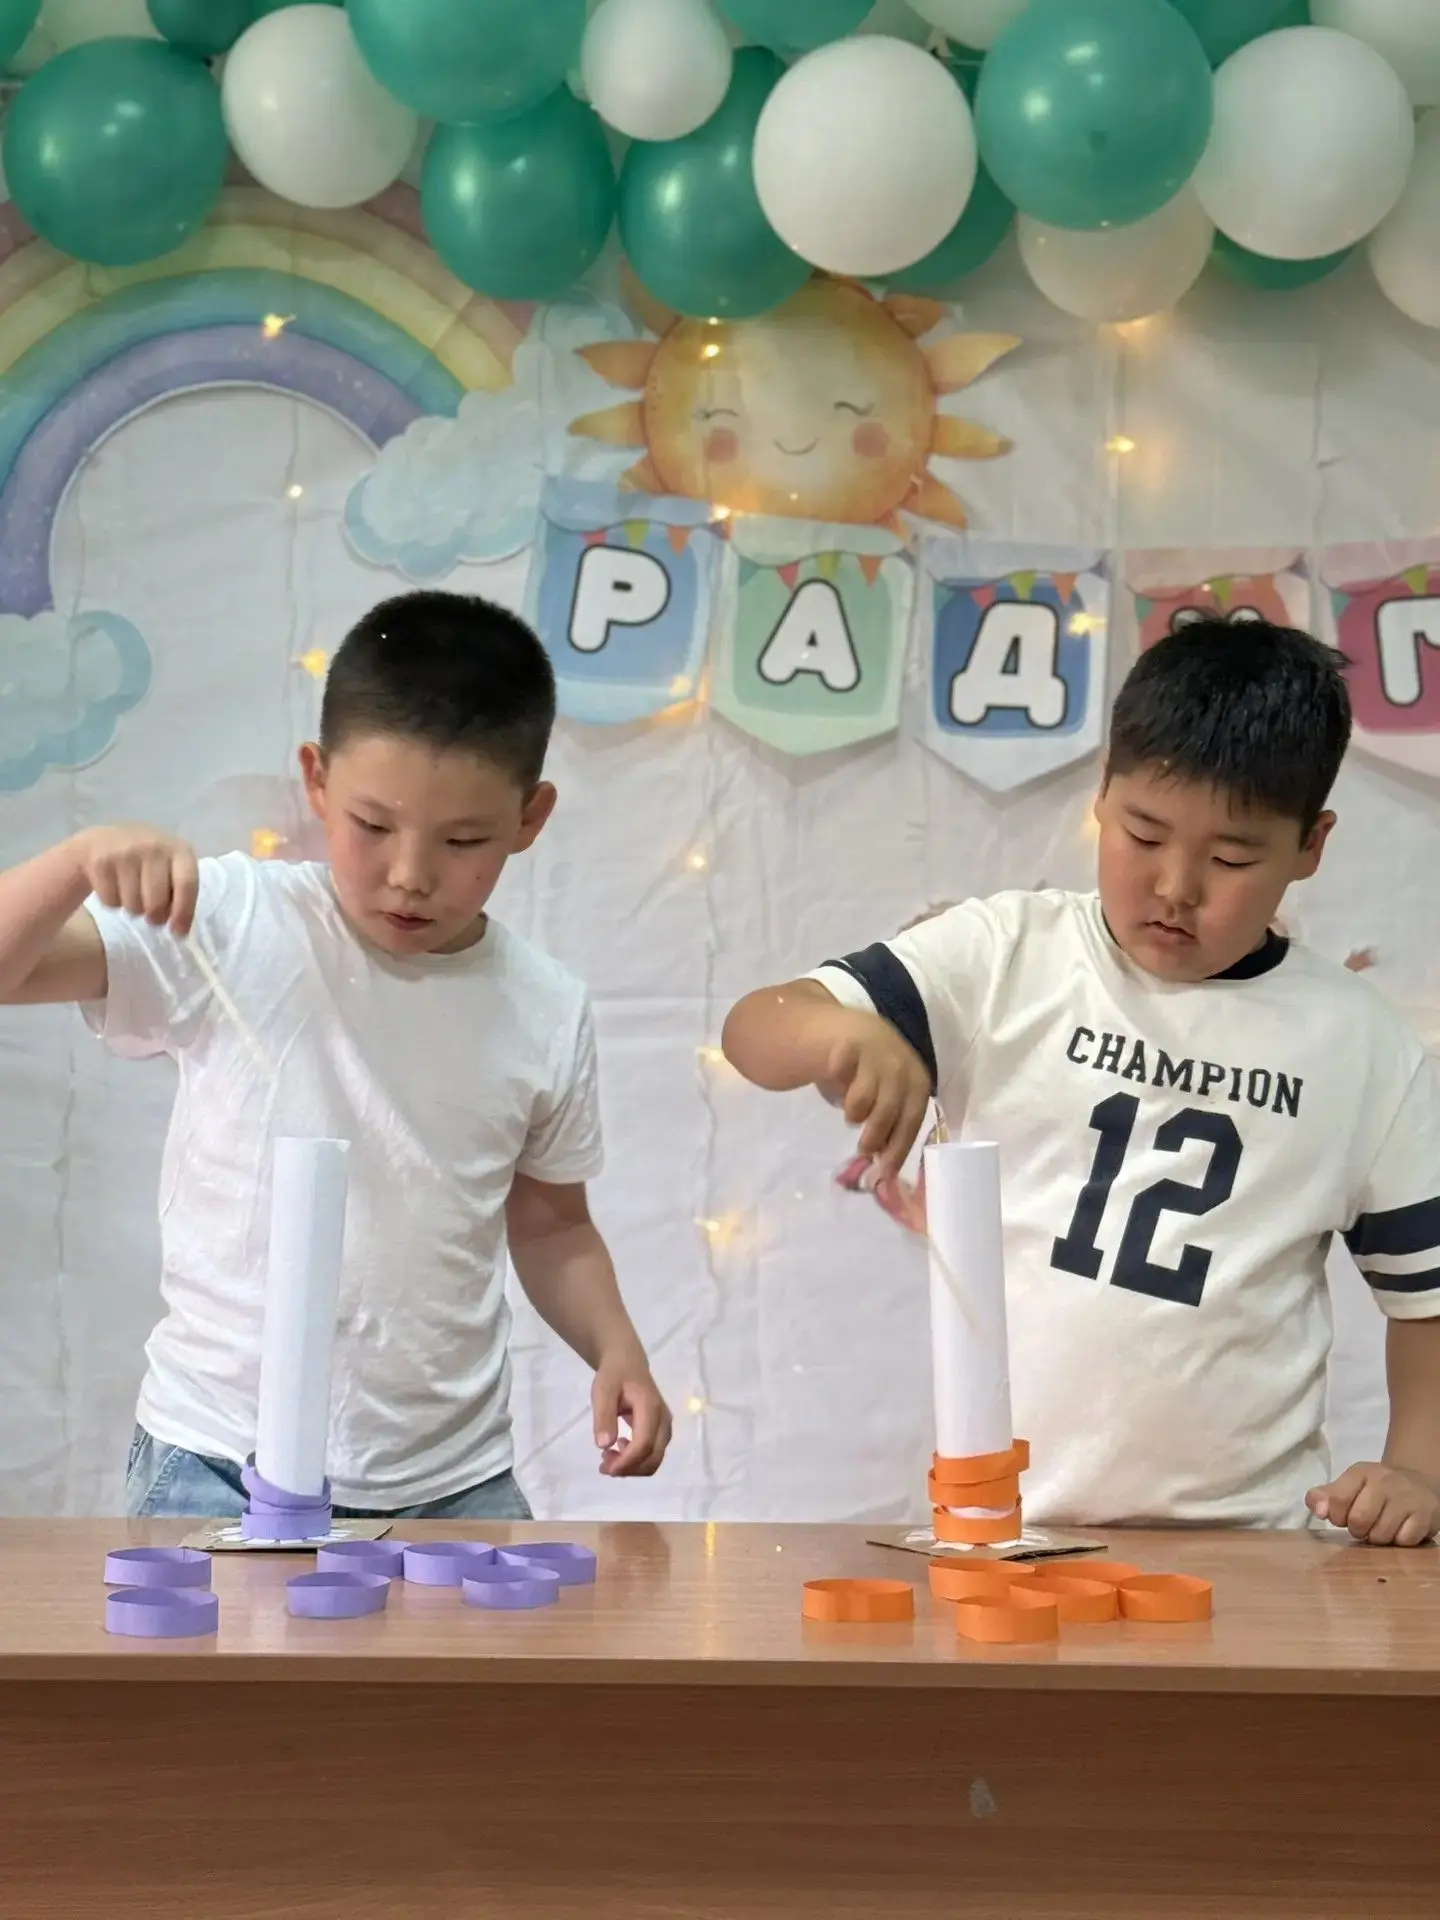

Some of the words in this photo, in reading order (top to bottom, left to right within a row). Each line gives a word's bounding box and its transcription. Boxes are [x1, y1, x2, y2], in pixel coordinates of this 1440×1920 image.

[568, 544, 1440, 730] РАДГ
[1066, 1026, 1304, 1118] CHAMPION
[1050, 1091, 1244, 1307] 12
